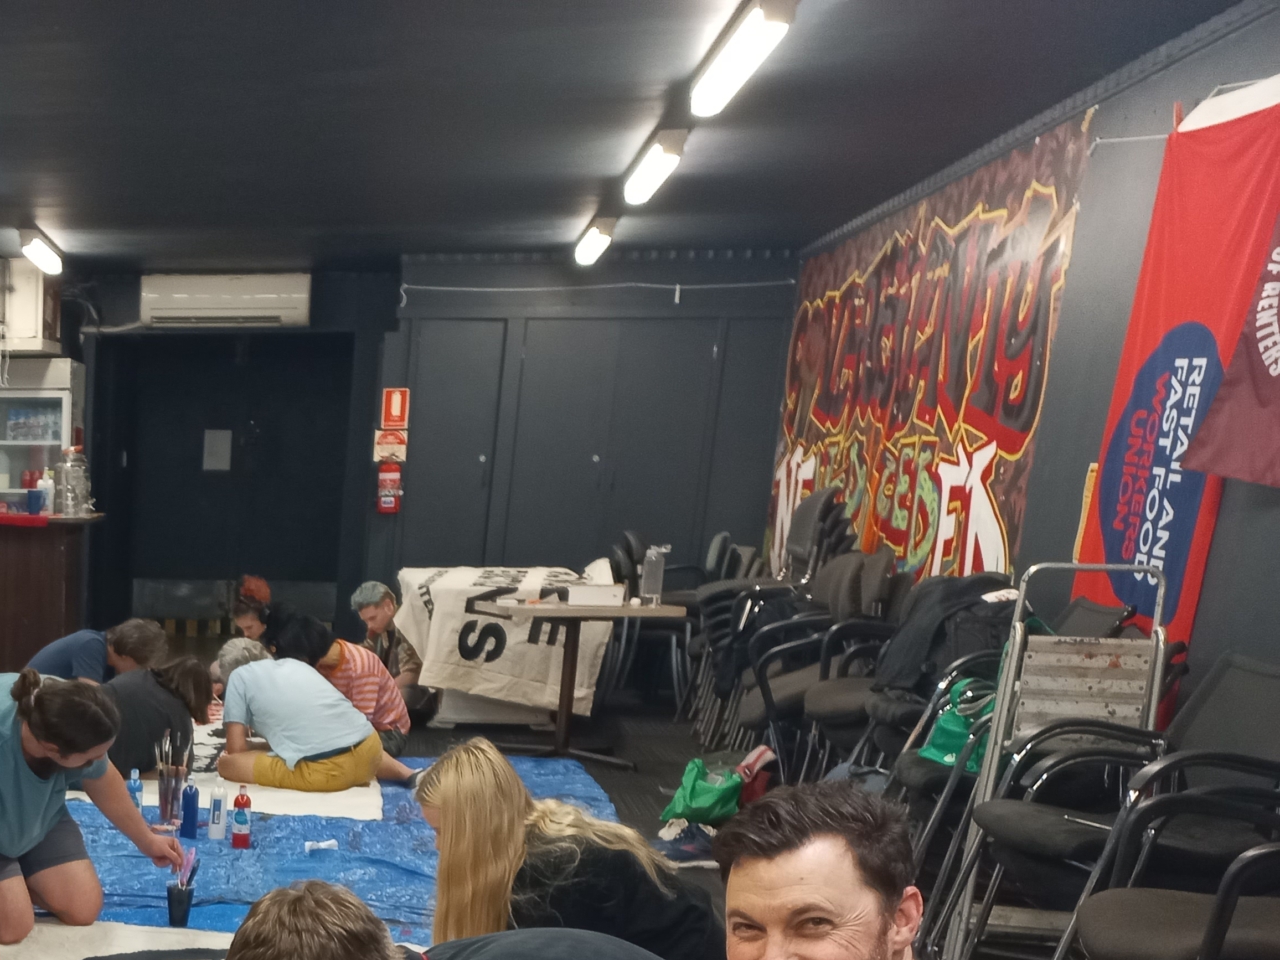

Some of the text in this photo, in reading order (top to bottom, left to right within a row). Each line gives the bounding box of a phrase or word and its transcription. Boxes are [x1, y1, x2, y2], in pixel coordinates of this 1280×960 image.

[1113, 409, 1148, 530] UNION
[1121, 370, 1170, 560] WORKERS
[1133, 358, 1189, 581] FAST FOOD
[1166, 357, 1208, 490] RETAIL
